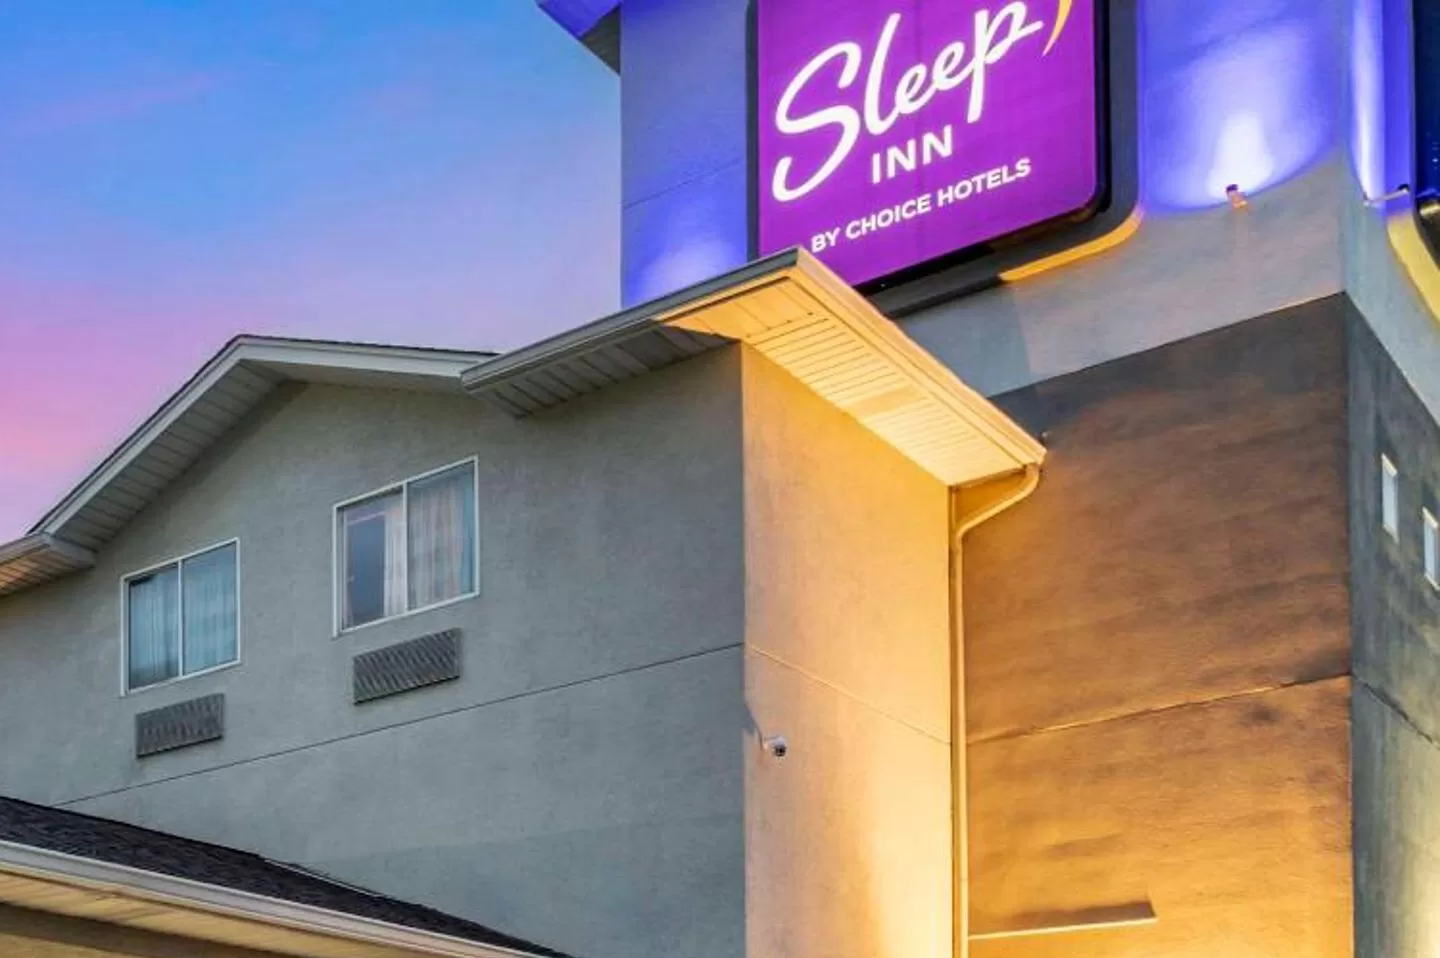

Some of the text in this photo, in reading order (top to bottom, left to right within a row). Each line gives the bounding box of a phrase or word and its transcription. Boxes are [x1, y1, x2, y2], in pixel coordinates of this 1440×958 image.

[772, 1, 1043, 202] Sleep
[872, 125, 953, 184] INN
[811, 157, 1032, 253] BY CHOICE HOTELS
